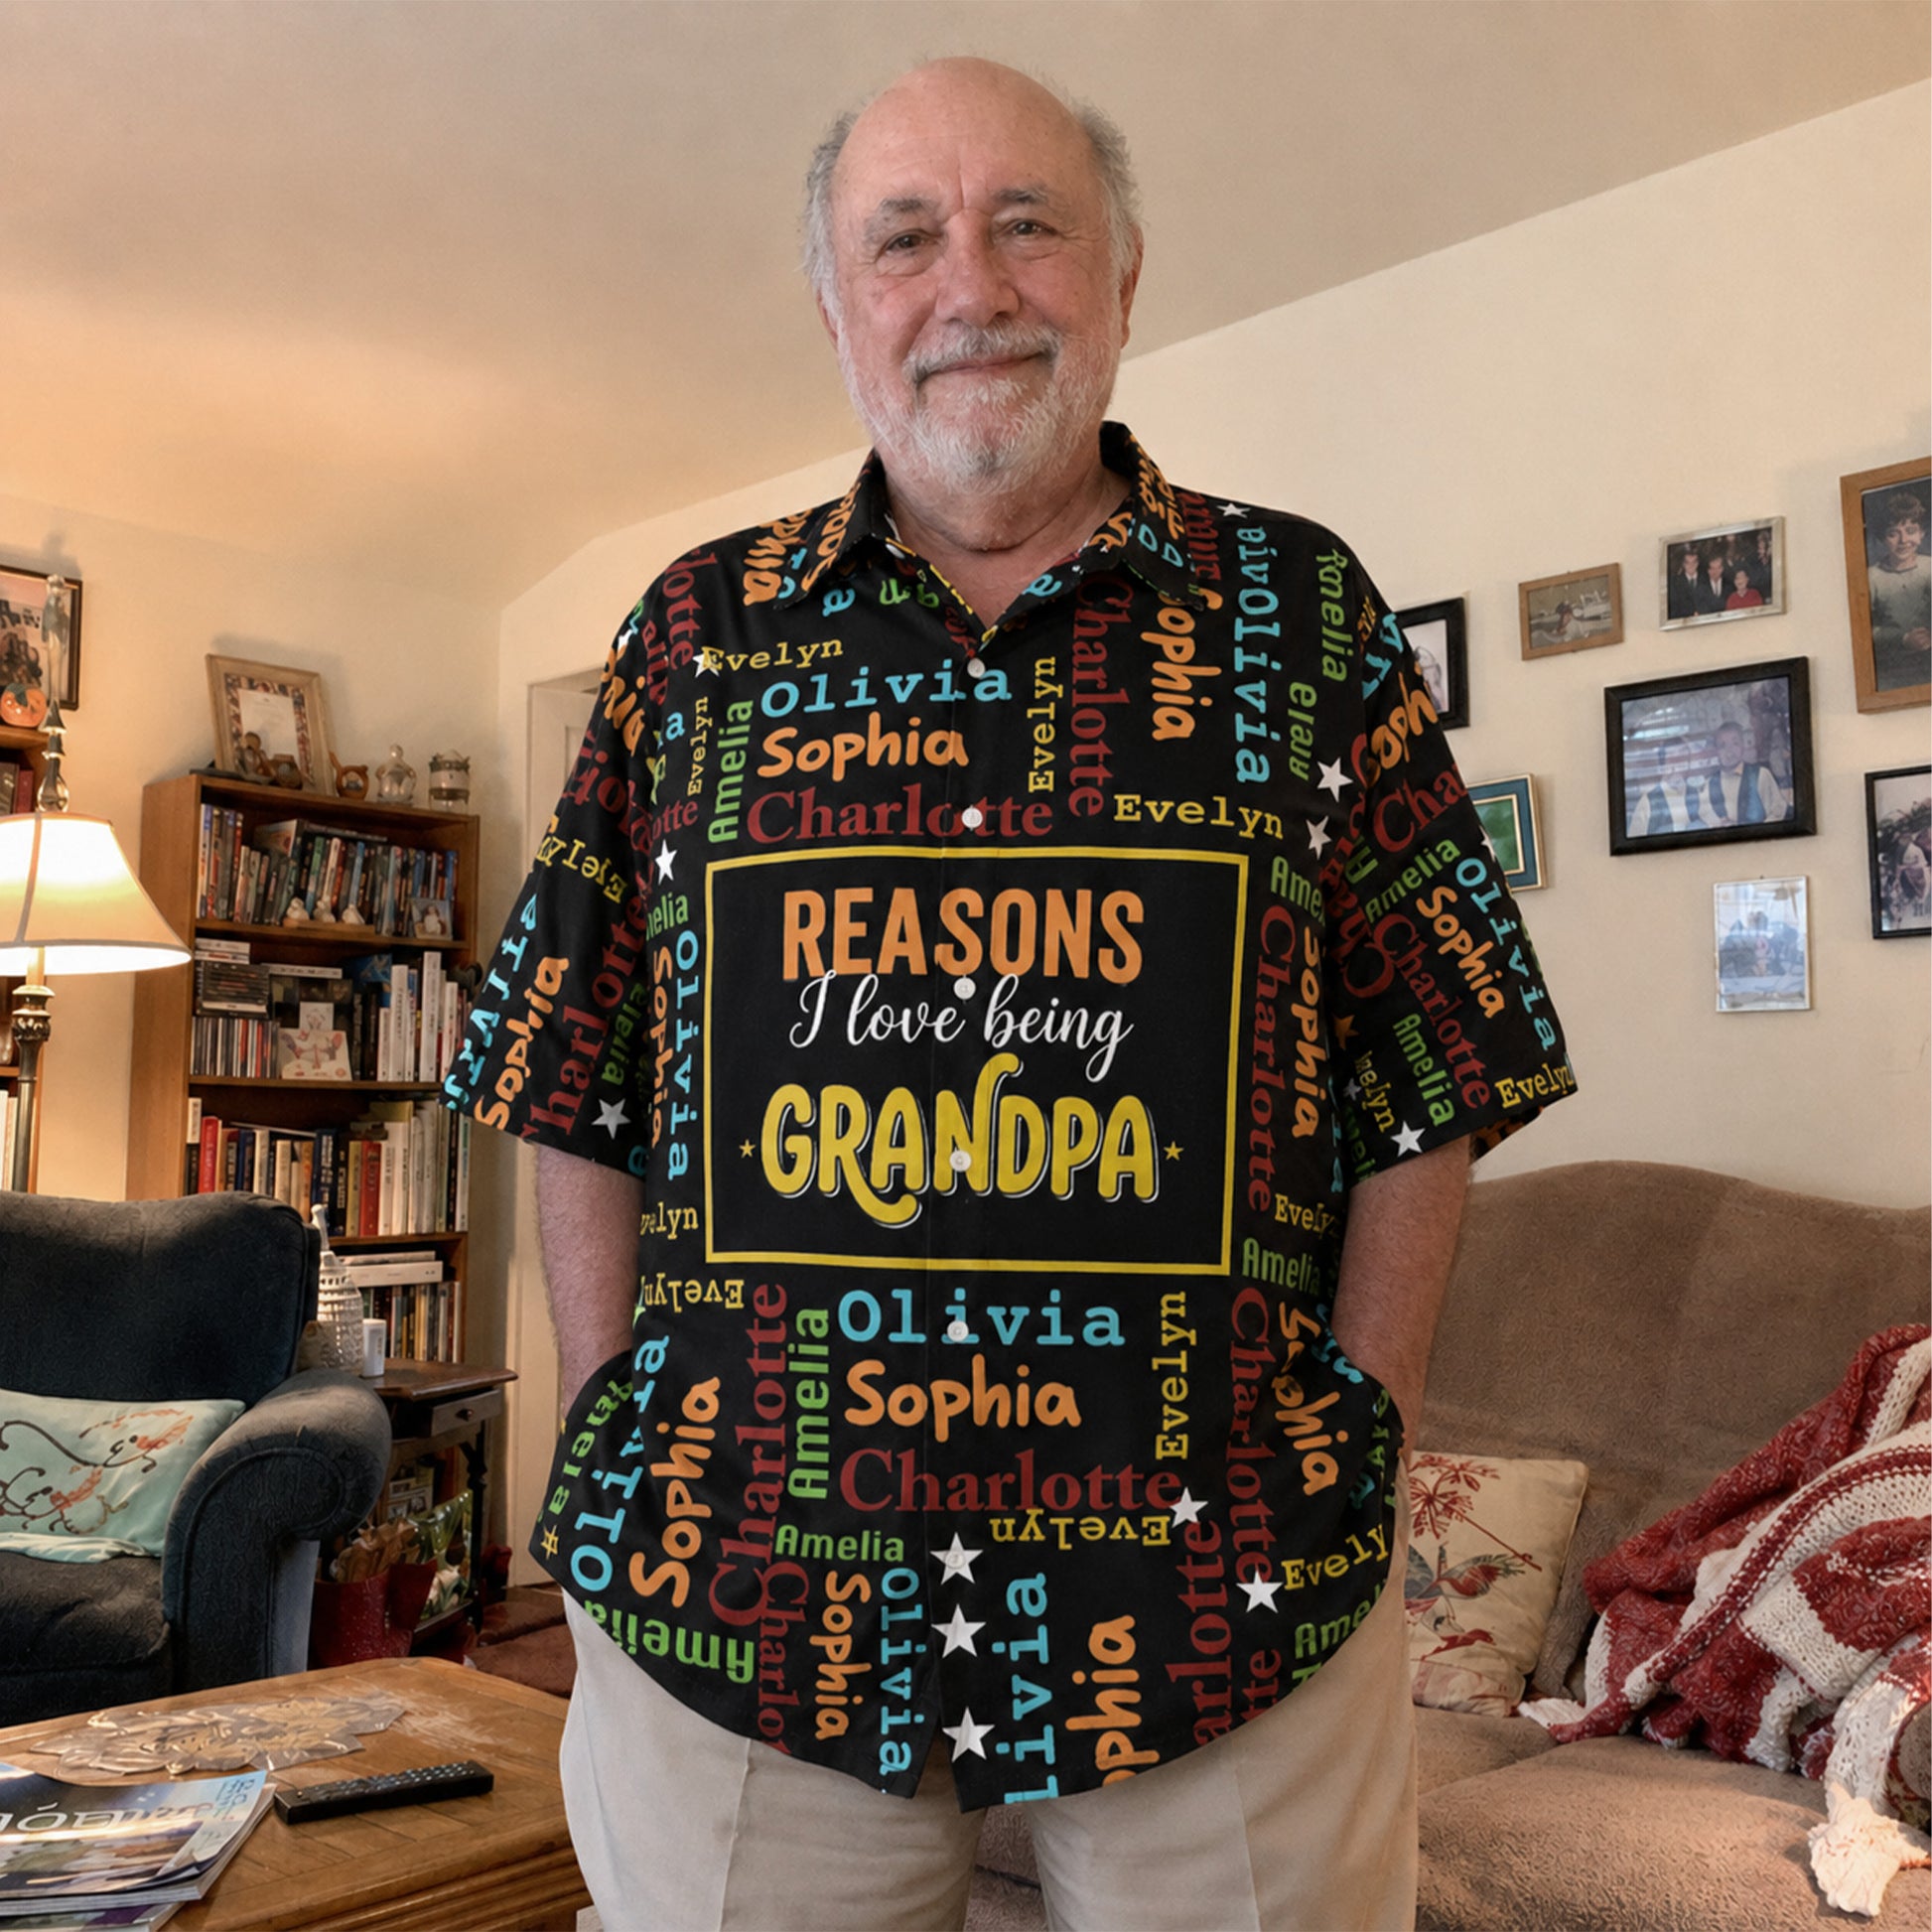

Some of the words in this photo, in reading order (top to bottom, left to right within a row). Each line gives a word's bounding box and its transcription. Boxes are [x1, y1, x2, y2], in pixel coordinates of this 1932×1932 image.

[701, 637, 844, 673] Evelyn
[760, 658, 1011, 718] Olivia
[687, 696, 713, 796] Evelyn
[708, 699, 754, 843] Amelia
[757, 711, 969, 782] Sophia
[1029, 656, 1063, 793] Evelyn
[747, 783, 1051, 844] Charlotte
[1113, 793, 1285, 840] Evelyn
[783, 888, 1144, 985] REASONS
[1365, 838, 1461, 923] Amelia
[1416, 886, 1506, 1019] Sophia
[1455, 858, 1557, 1051] Olivia
[668, 930, 699, 1180] Olivia
[789, 969, 838, 1048] I
[846, 973, 966, 1047] love
[983, 974, 1134, 1082] being
[1246, 905, 1297, 1212] Charlotte
[1373, 913, 1492, 1109] Charlotte
[1392, 1014, 1455, 1127] Amelia
[760, 1052, 1161, 1229] GRANDPA
[838, 1288, 1125, 1346] Olivia
[788, 1308, 830, 1499] Amelia
[845, 1353, 1081, 1444] Sophia
[1152, 1292, 1197, 1460] Evelyn
[629, 1376, 721, 1608] Sophia
[709, 1284, 787, 1626] Charlotte
[840, 1449, 1183, 1513] Charlotte
[774, 1525, 904, 1562] Amelia
[989, 1508, 1172, 1550] Evelyn
[808, 1570, 872, 1740] Sophia
[880, 1567, 927, 1775] Olivia
